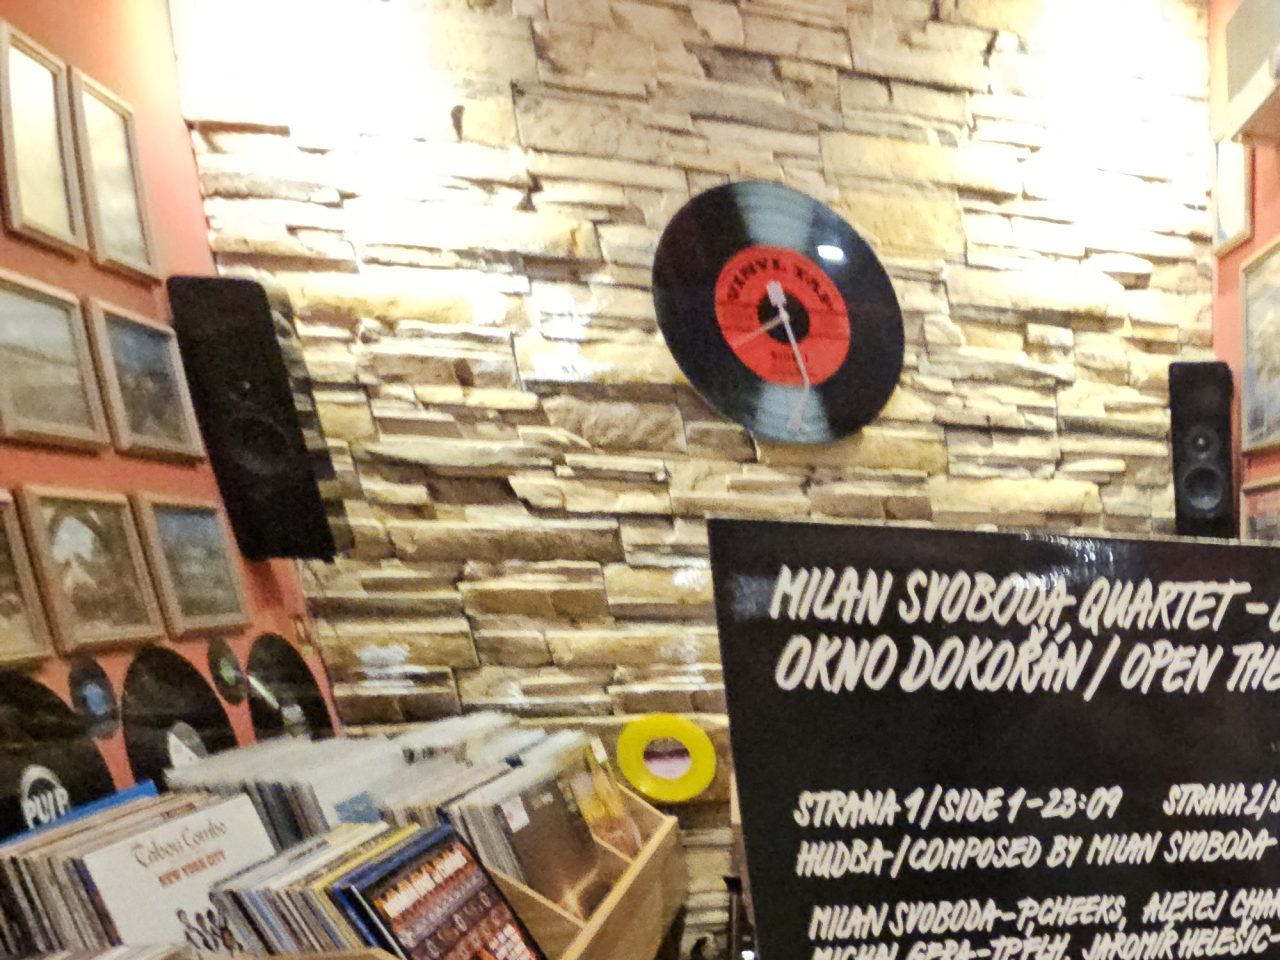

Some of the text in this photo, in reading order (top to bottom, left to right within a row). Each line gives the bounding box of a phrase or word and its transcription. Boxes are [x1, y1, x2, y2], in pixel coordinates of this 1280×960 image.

[770, 564, 893, 626] MILAN
[899, 569, 1077, 630] SVOBODA
[1078, 576, 1251, 637] QUARTET
[775, 633, 898, 694] OKNO
[899, 622, 1093, 694] DOKOŘÁN
[1121, 639, 1225, 695] OPEN
[793, 786, 901, 829] STRANA
[1163, 782, 1247, 816] STRANA
[1046, 834, 1083, 869] BY
[1086, 830, 1162, 866] MILAN
[1163, 827, 1278, 864] SVOBODA
[808, 902, 889, 941] MILAN
[1142, 889, 1229, 925] ALEXEJ
